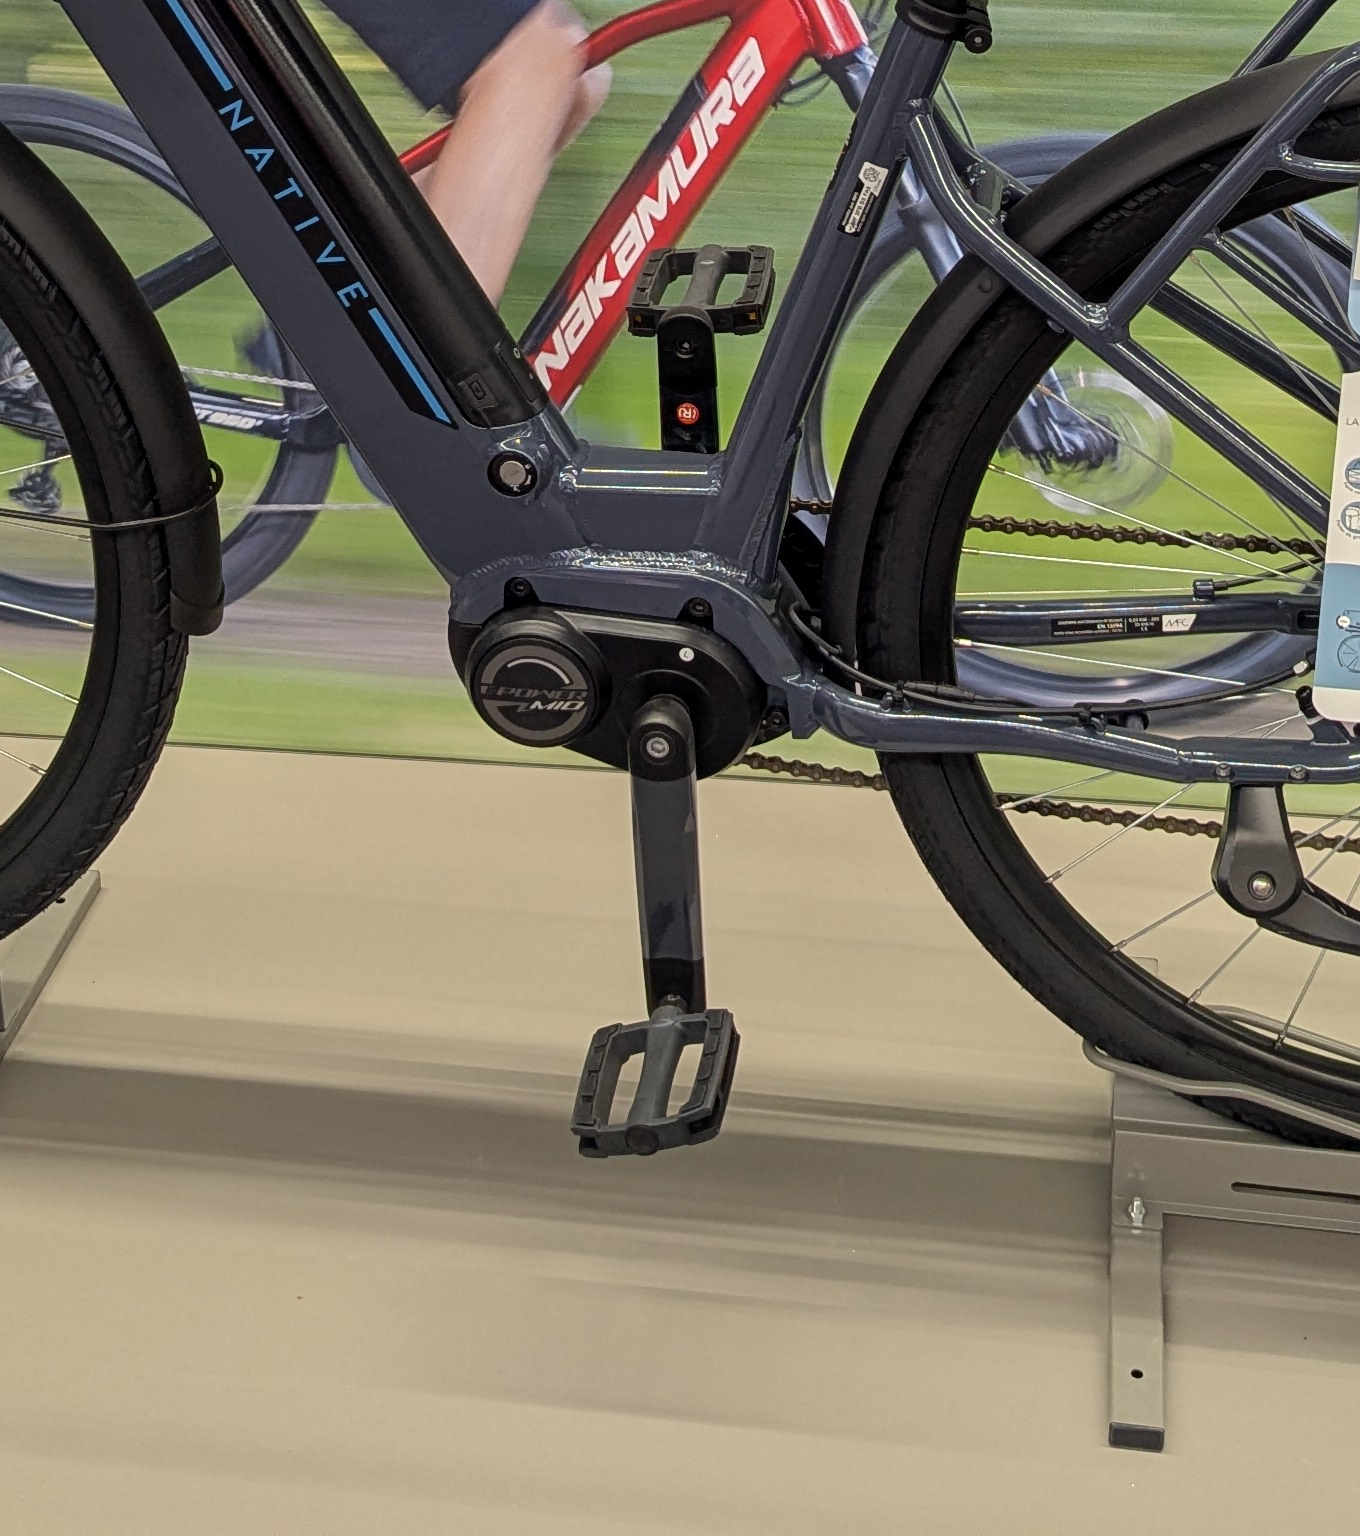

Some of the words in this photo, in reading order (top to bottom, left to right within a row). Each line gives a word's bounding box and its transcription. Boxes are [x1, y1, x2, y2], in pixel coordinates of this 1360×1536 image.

[219, 100, 370, 308] NATIVE
[529, 36, 766, 391] NAKAMURA
[1346, 417, 1359, 427] LA
